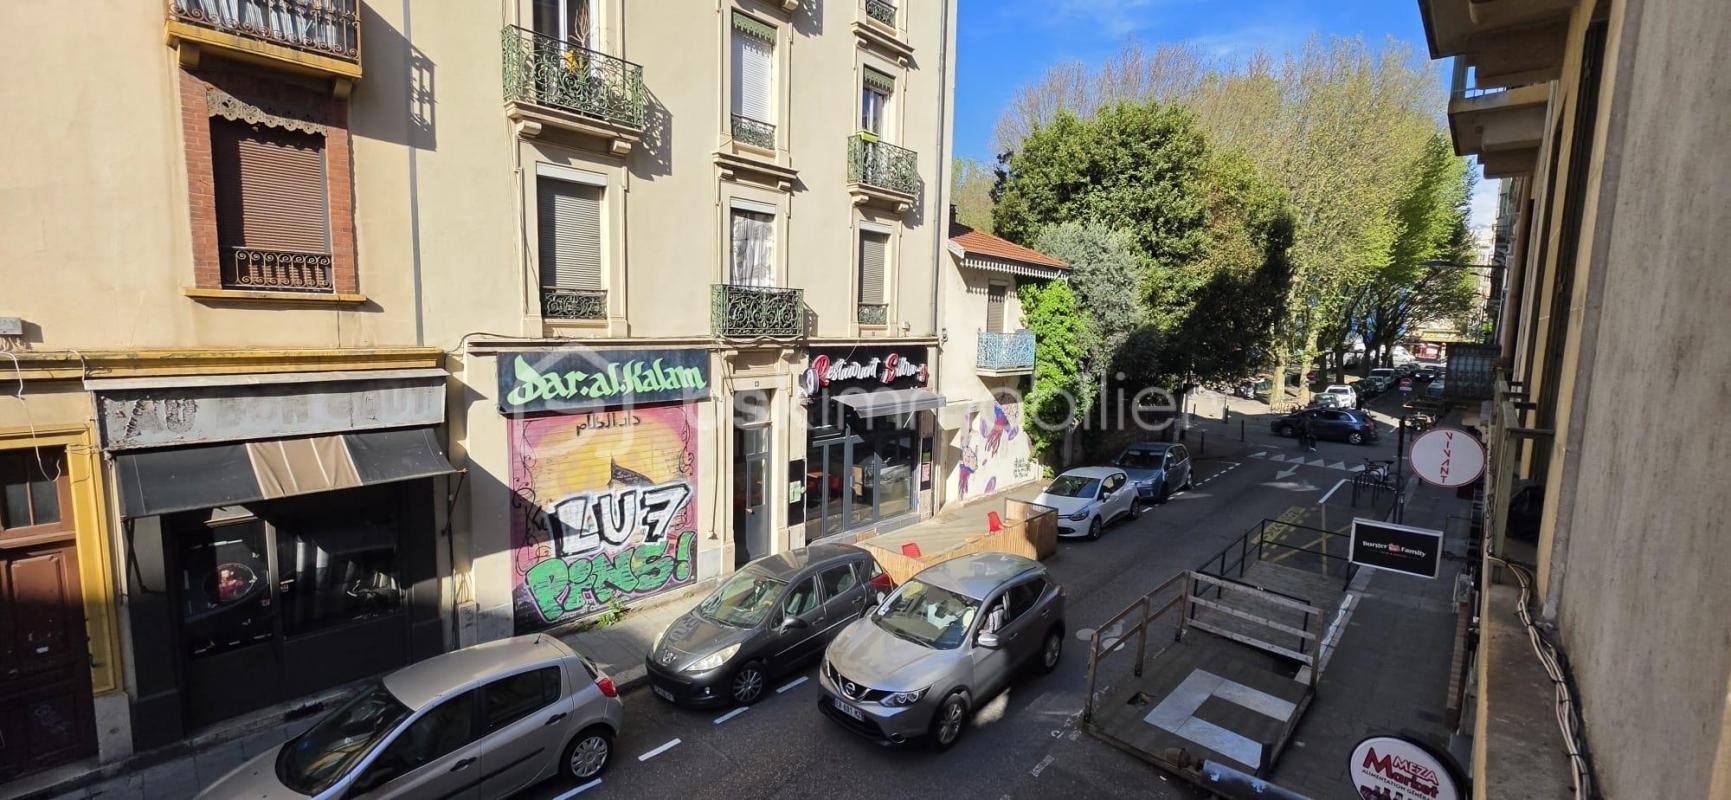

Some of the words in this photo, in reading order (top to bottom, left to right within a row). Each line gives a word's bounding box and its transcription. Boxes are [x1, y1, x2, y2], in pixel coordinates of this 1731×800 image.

[812, 354, 881, 386] Restaurant
[1439, 431, 1453, 483] VIVANT
[1362, 746, 1439, 799] Market
[1393, 756, 1439, 786] MEZA
